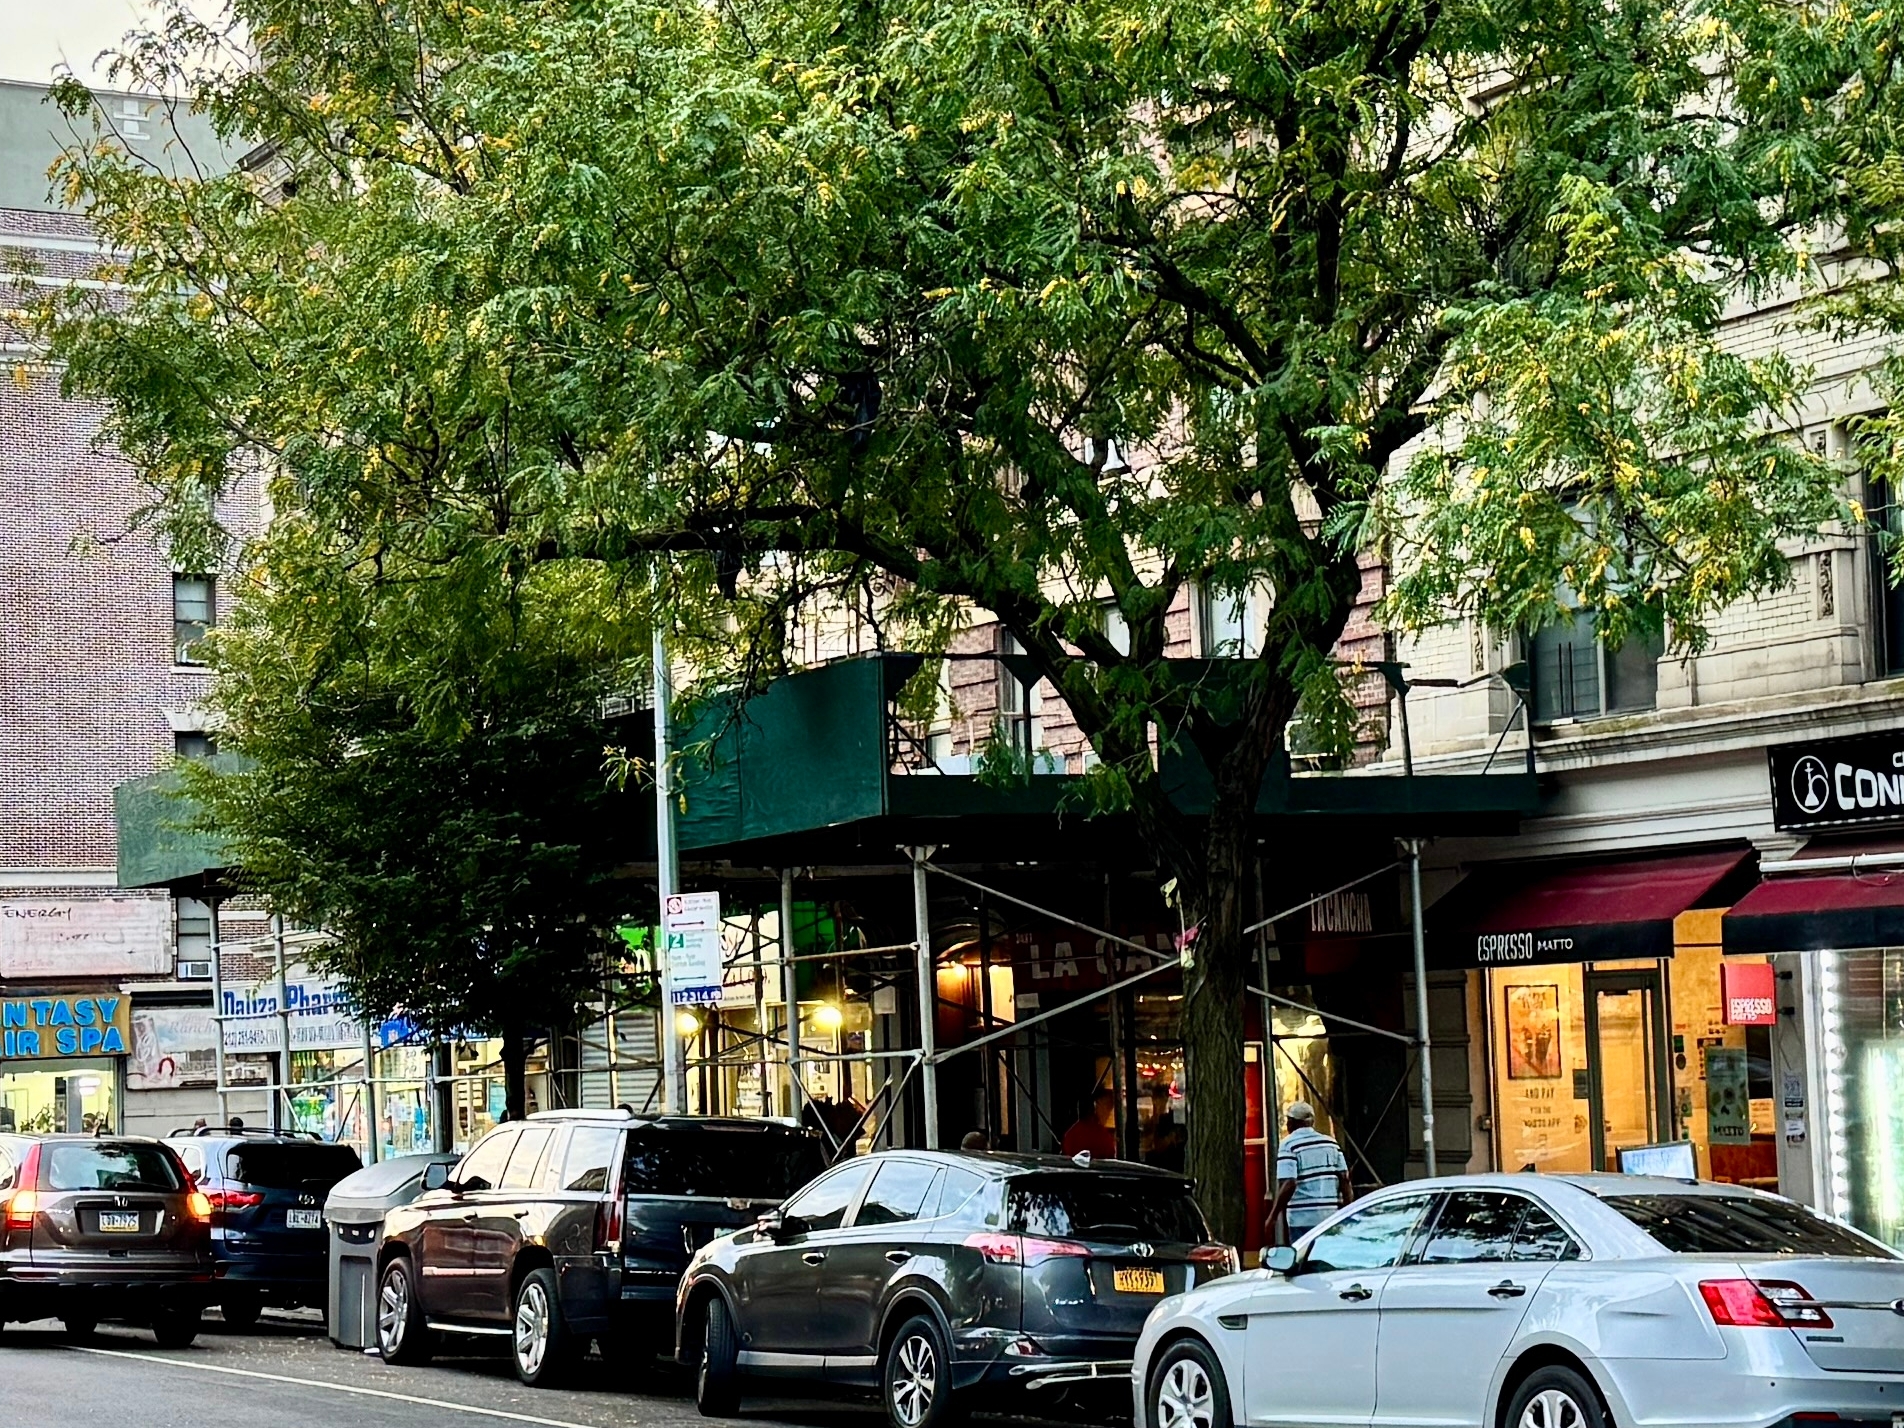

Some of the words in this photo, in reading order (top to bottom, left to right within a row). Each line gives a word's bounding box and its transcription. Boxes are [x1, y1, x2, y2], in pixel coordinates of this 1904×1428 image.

[1030, 941, 1079, 979] LA
[1477, 932, 1533, 962] ESPRESSO
[1537, 937, 1574, 952] MATTO
[55, 1025, 125, 1055] SPA
